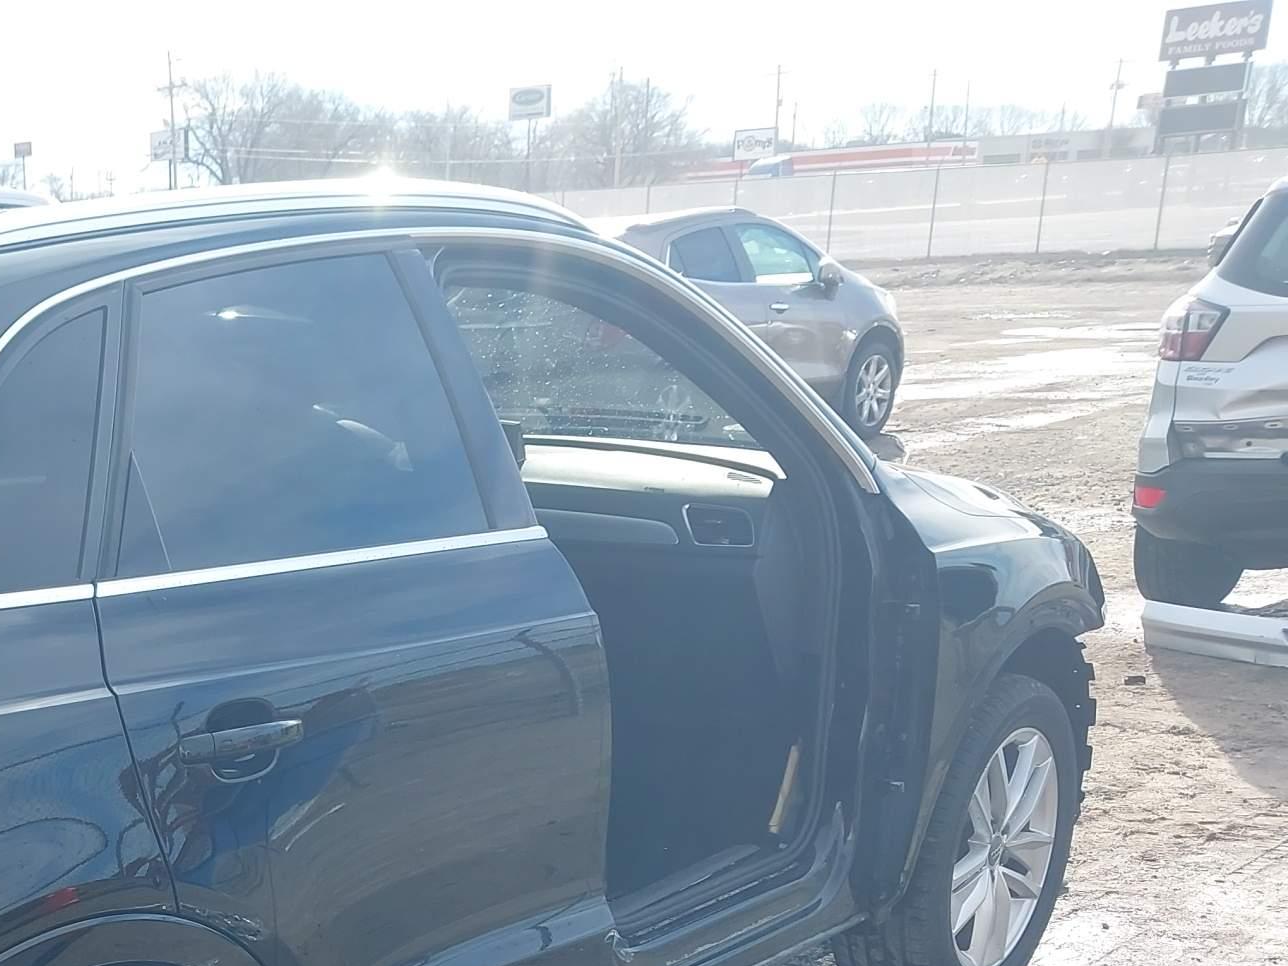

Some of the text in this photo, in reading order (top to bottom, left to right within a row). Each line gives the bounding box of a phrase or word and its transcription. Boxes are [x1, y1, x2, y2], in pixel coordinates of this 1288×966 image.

[1165, 10, 1264, 43] Leeker's
[1168, 37, 1255, 55] FAMILY FOODS
